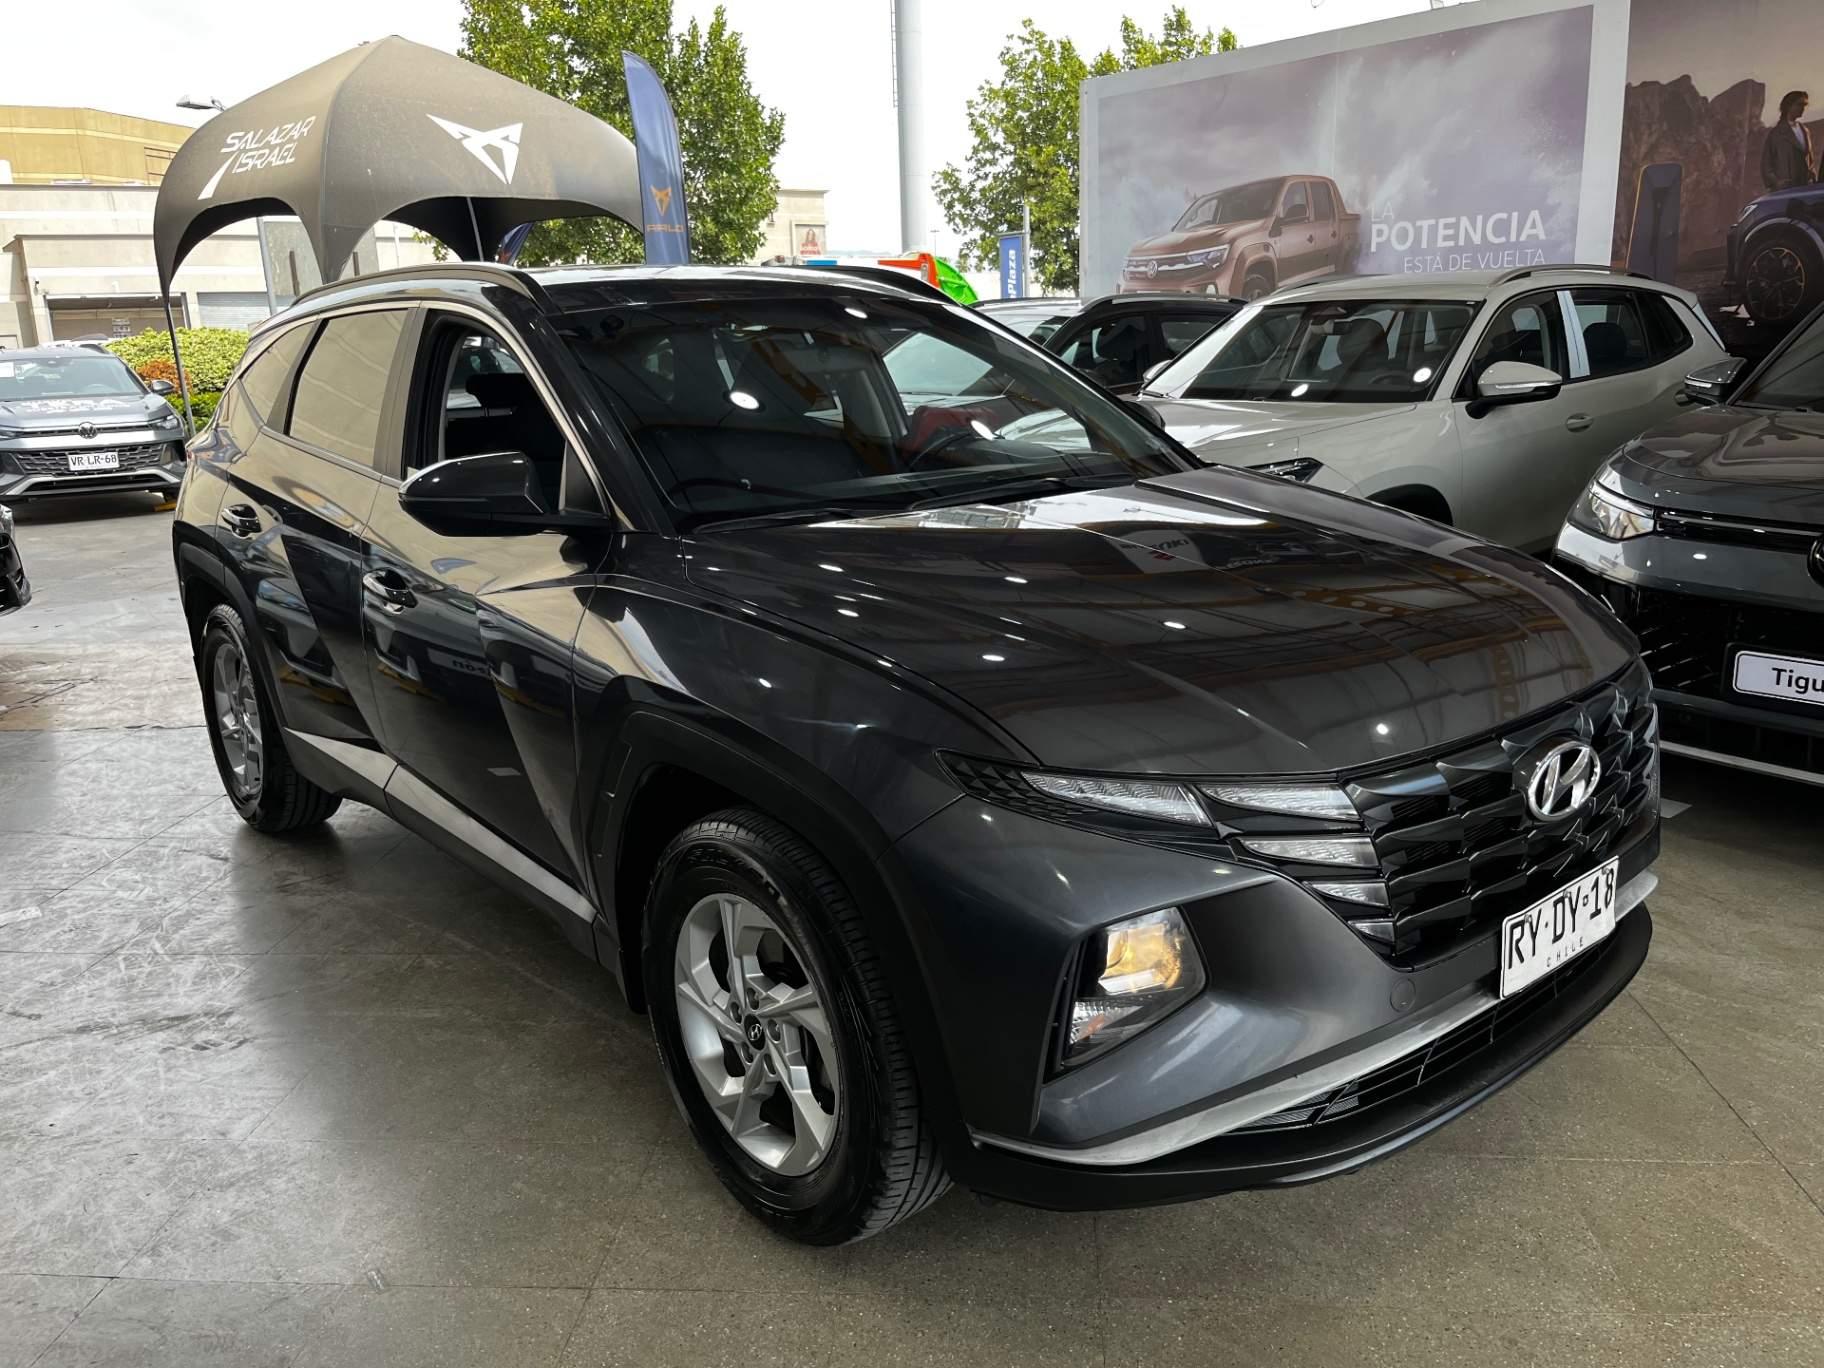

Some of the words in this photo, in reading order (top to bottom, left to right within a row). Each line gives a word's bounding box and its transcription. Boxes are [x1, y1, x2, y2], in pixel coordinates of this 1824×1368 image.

[220, 115, 317, 153] SALAZAR
[231, 141, 297, 174] ISRAEL
[1370, 202, 1395, 222] LA
[1370, 209, 1547, 252] POTENCIA
[1449, 253, 1473, 271] DE
[1477, 248, 1546, 269] VUELTA
[1546, 936, 1584, 968] CHILE
